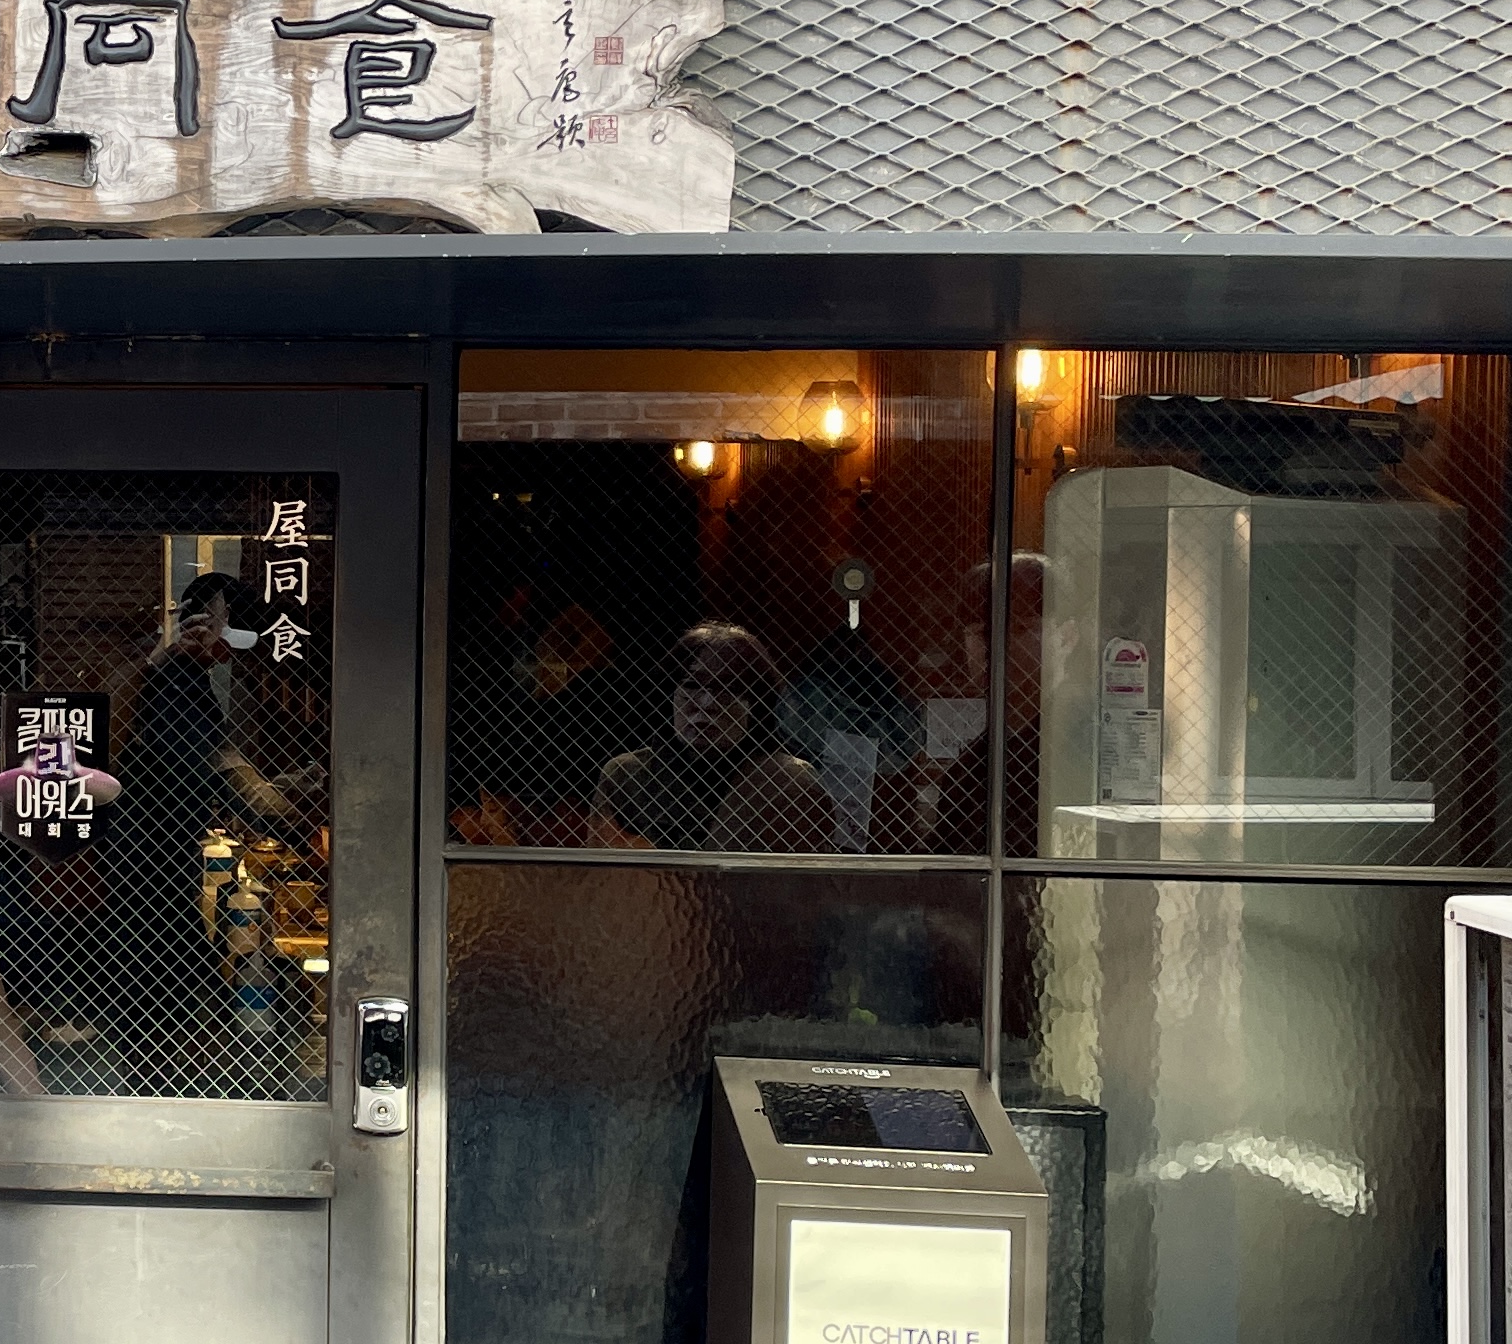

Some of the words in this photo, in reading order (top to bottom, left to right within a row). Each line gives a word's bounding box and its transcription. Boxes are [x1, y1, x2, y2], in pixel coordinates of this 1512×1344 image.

[260, 499, 312, 663] 屋同食
[16, 773, 94, 819] 어워즈
[812, 1066, 891, 1077] CATCHTABLE
